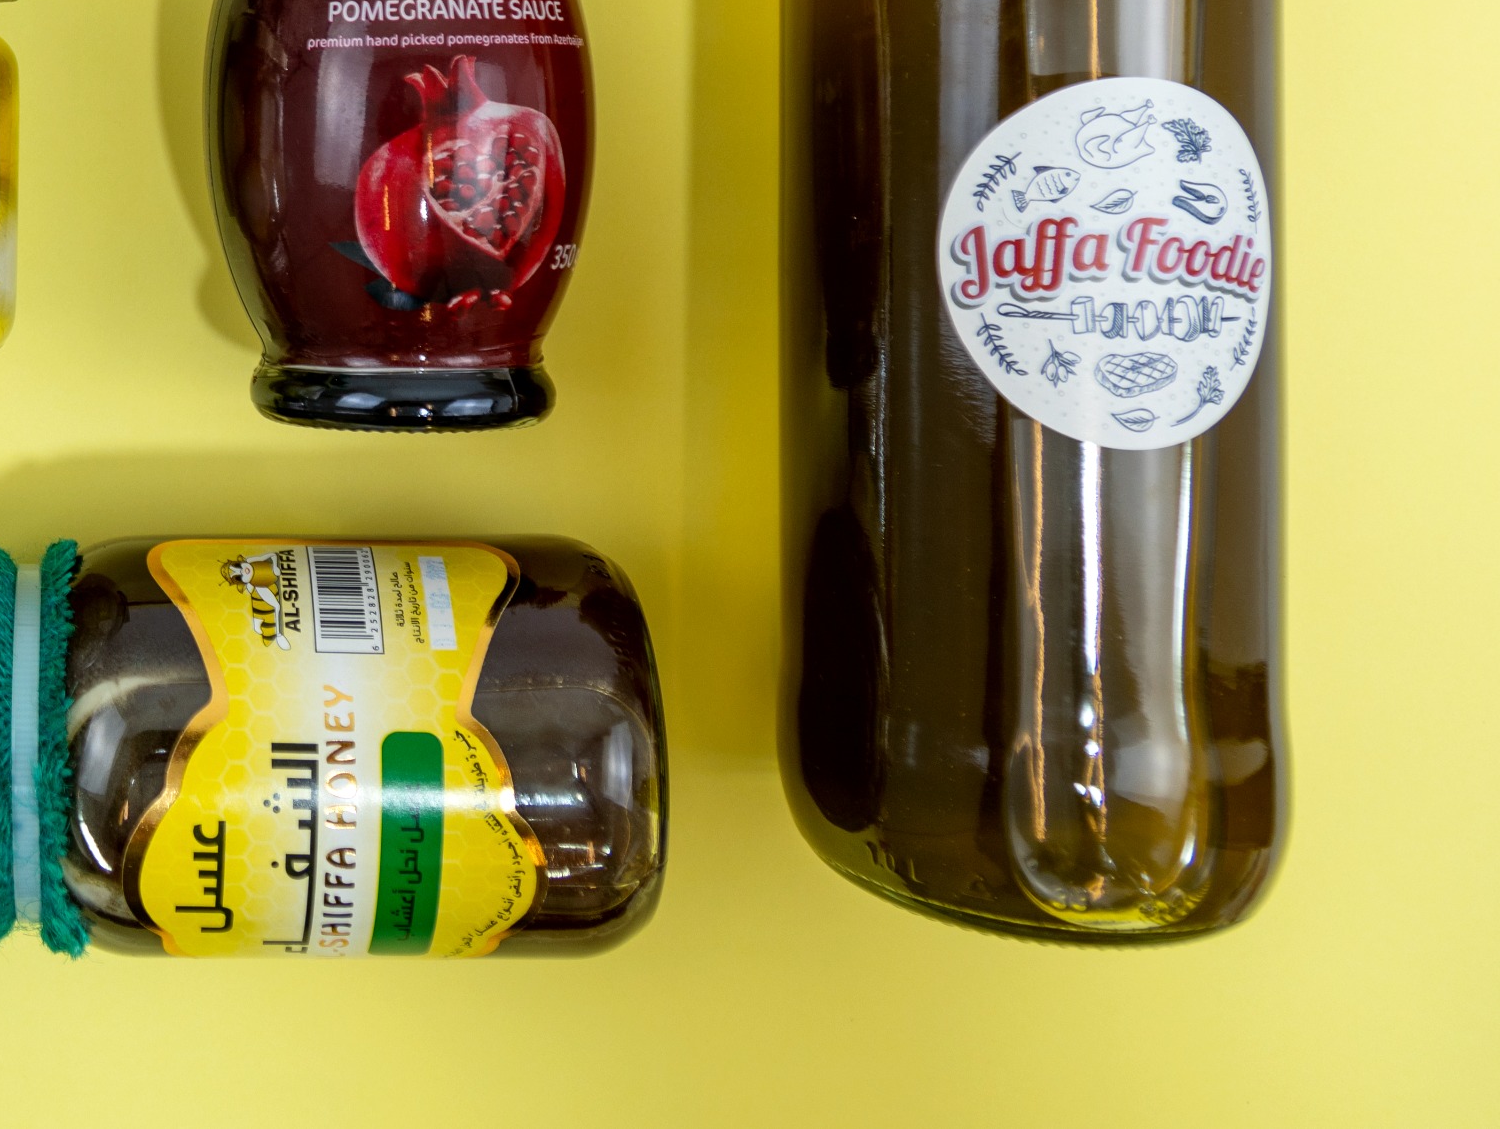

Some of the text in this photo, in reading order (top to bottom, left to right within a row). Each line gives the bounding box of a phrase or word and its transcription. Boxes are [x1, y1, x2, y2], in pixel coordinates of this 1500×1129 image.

[328, 0, 564, 22] POMEGRANATE SAUCE
[307, 36, 363, 50] premium
[366, 35, 398, 47] hand
[402, 33, 444, 49] picked
[448, 35, 529, 49] pomegranates
[531, 33, 552, 44] from
[551, 243, 580, 270] 350
[960, 217, 1265, 299] Jaffa Foodie
[362, 549, 372, 581] 290062
[404, 562, 414, 583] سنوات
[278, 549, 301, 632] AL-SHIFFA
[389, 572, 405, 627] صالح لمدة ثلاثة
[408, 584, 418, 595] من
[408, 597, 421, 615] تاريخ
[366, 588, 379, 633] 252828
[318, 684, 357, 957] L-SHIFFA HONEY
[263, 743, 319, 953] الشفاء
[399, 850, 422, 884] نحل
[176, 821, 233, 933] عسل
[391, 889, 416, 941] أعشاب
